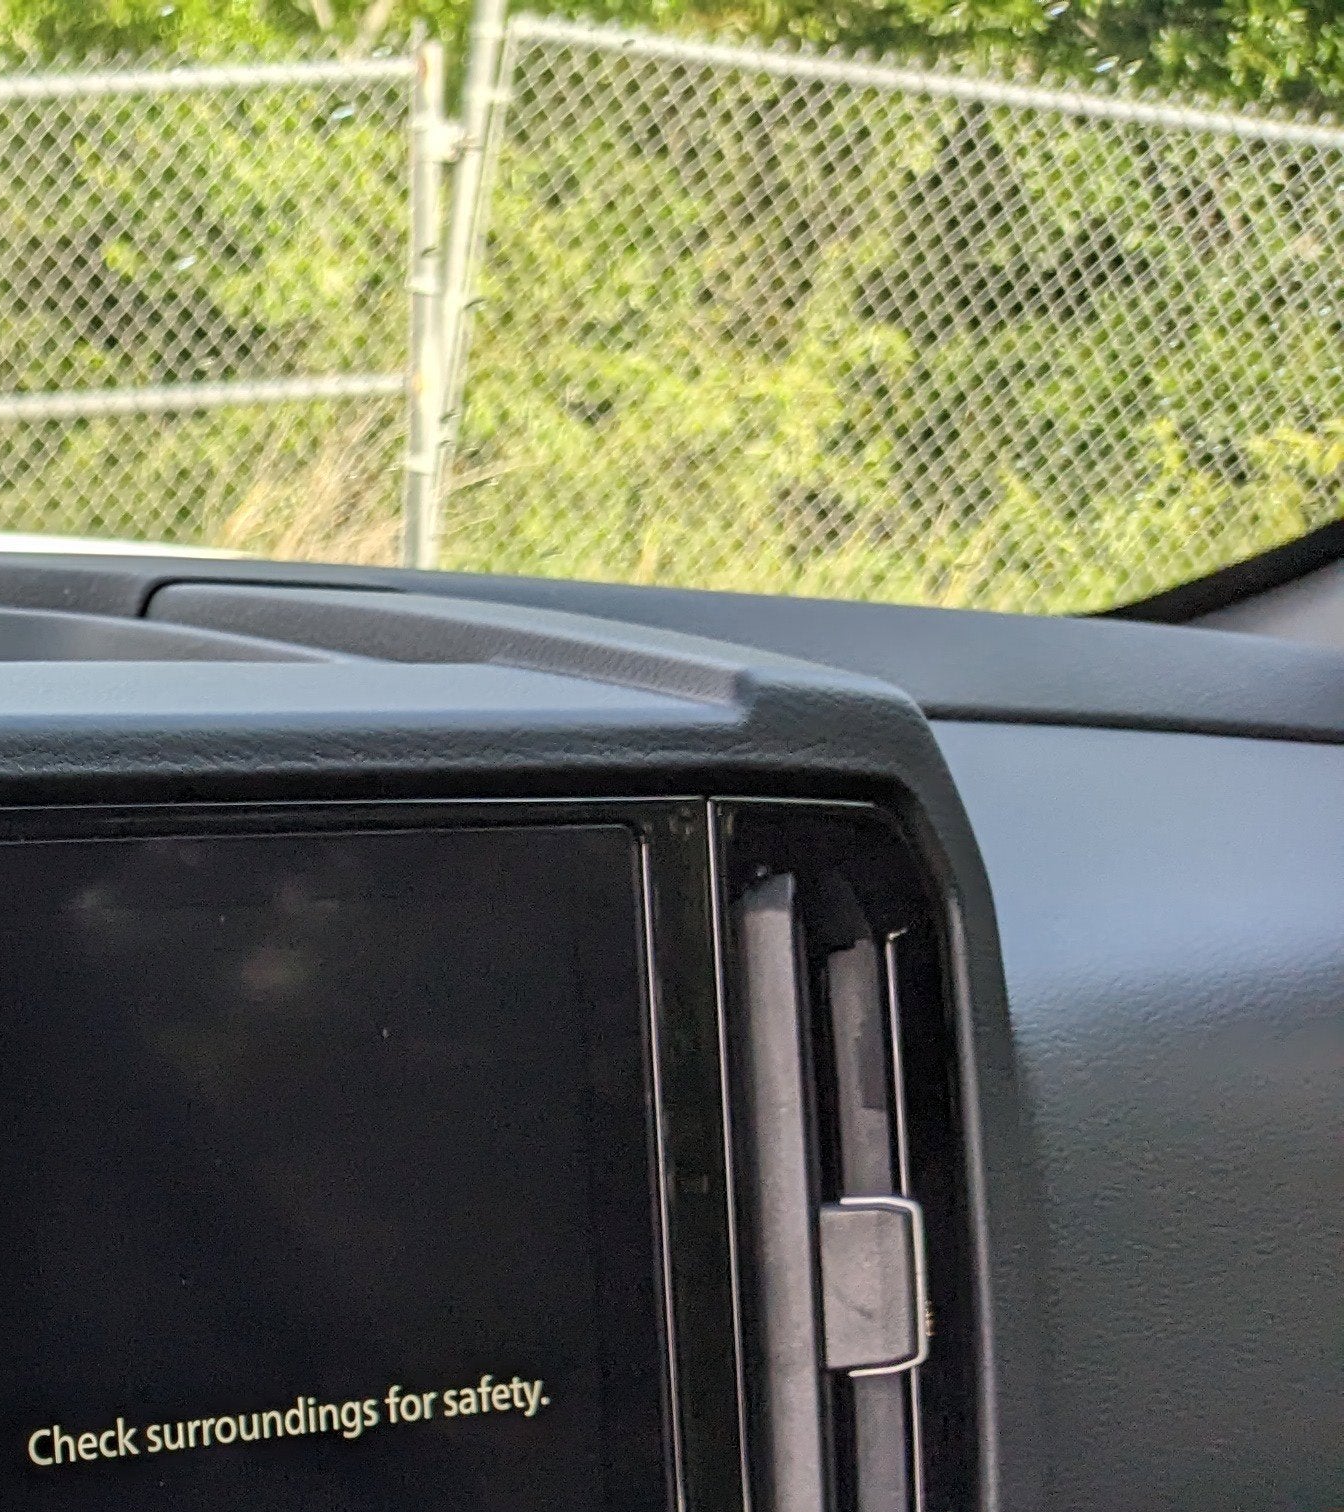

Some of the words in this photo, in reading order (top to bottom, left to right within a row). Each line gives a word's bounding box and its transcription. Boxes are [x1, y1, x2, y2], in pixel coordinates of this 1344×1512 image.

[28, 1418, 140, 1466] Check
[146, 1396, 379, 1454] surroundings
[384, 1385, 437, 1424] for
[443, 1375, 551, 1419] safety.
